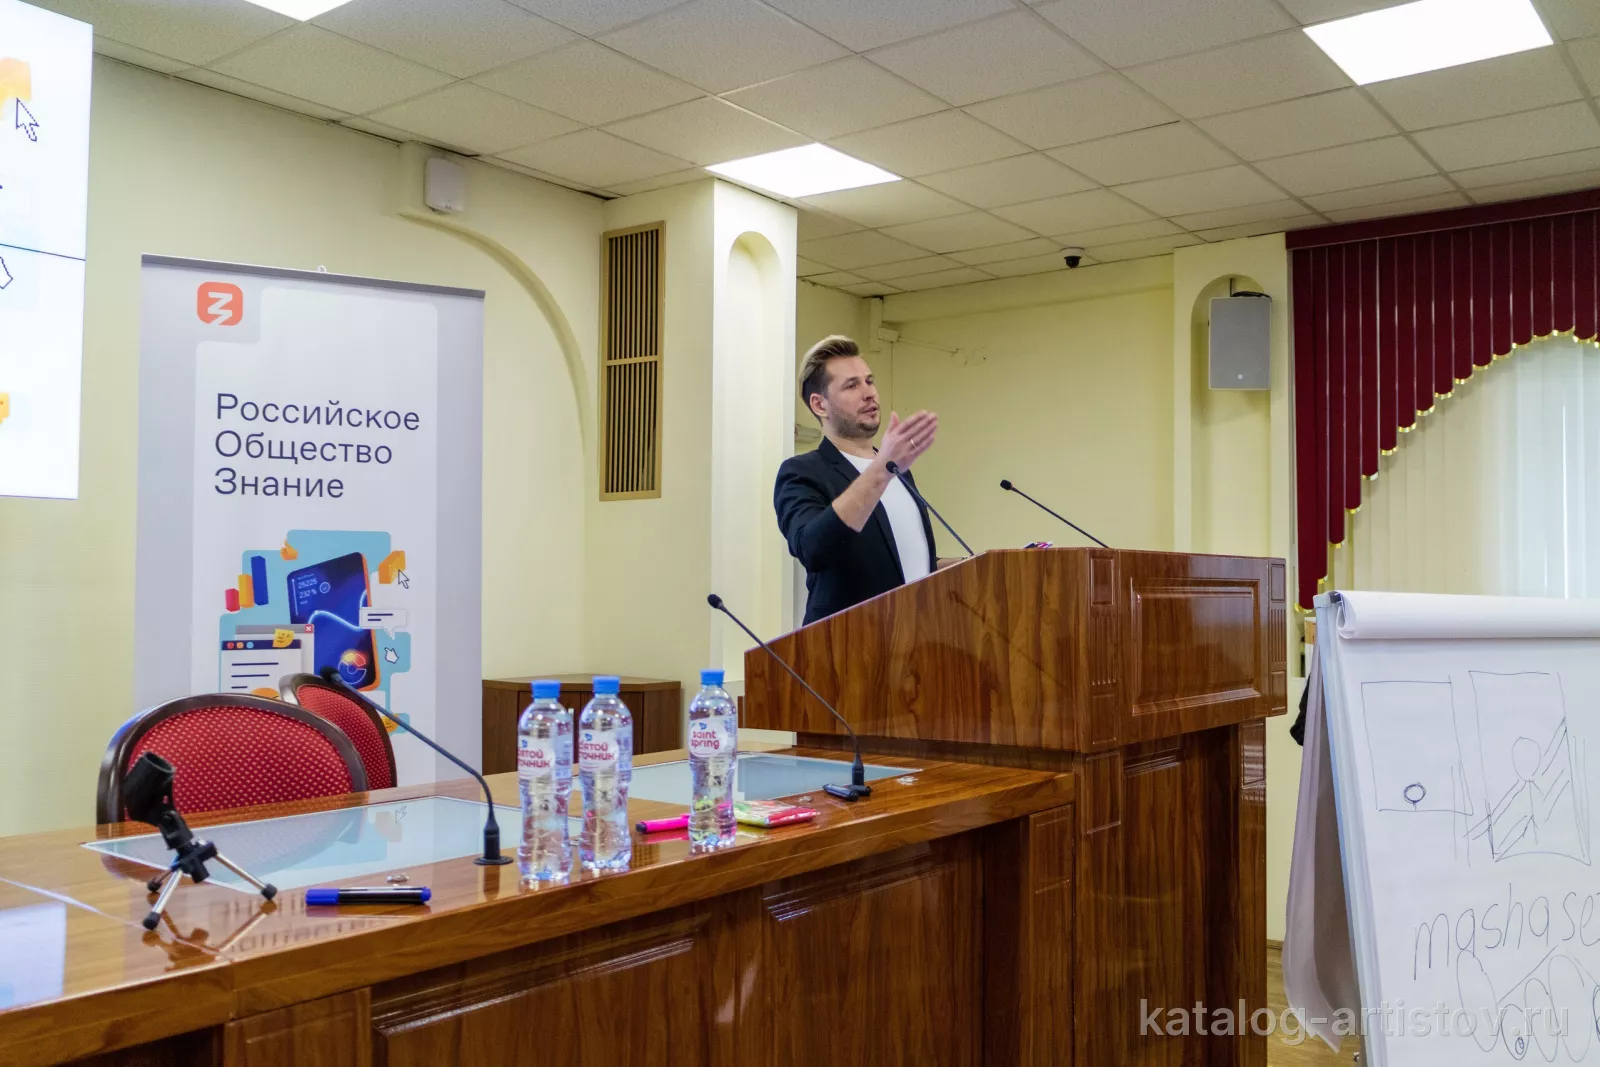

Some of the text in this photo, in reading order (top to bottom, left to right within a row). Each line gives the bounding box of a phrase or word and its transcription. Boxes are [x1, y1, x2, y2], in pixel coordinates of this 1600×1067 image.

[216, 392, 421, 431] Российское
[214, 429, 393, 465] Общество
[213, 466, 345, 498] Знание
[1413, 882, 1600, 980] mashase
